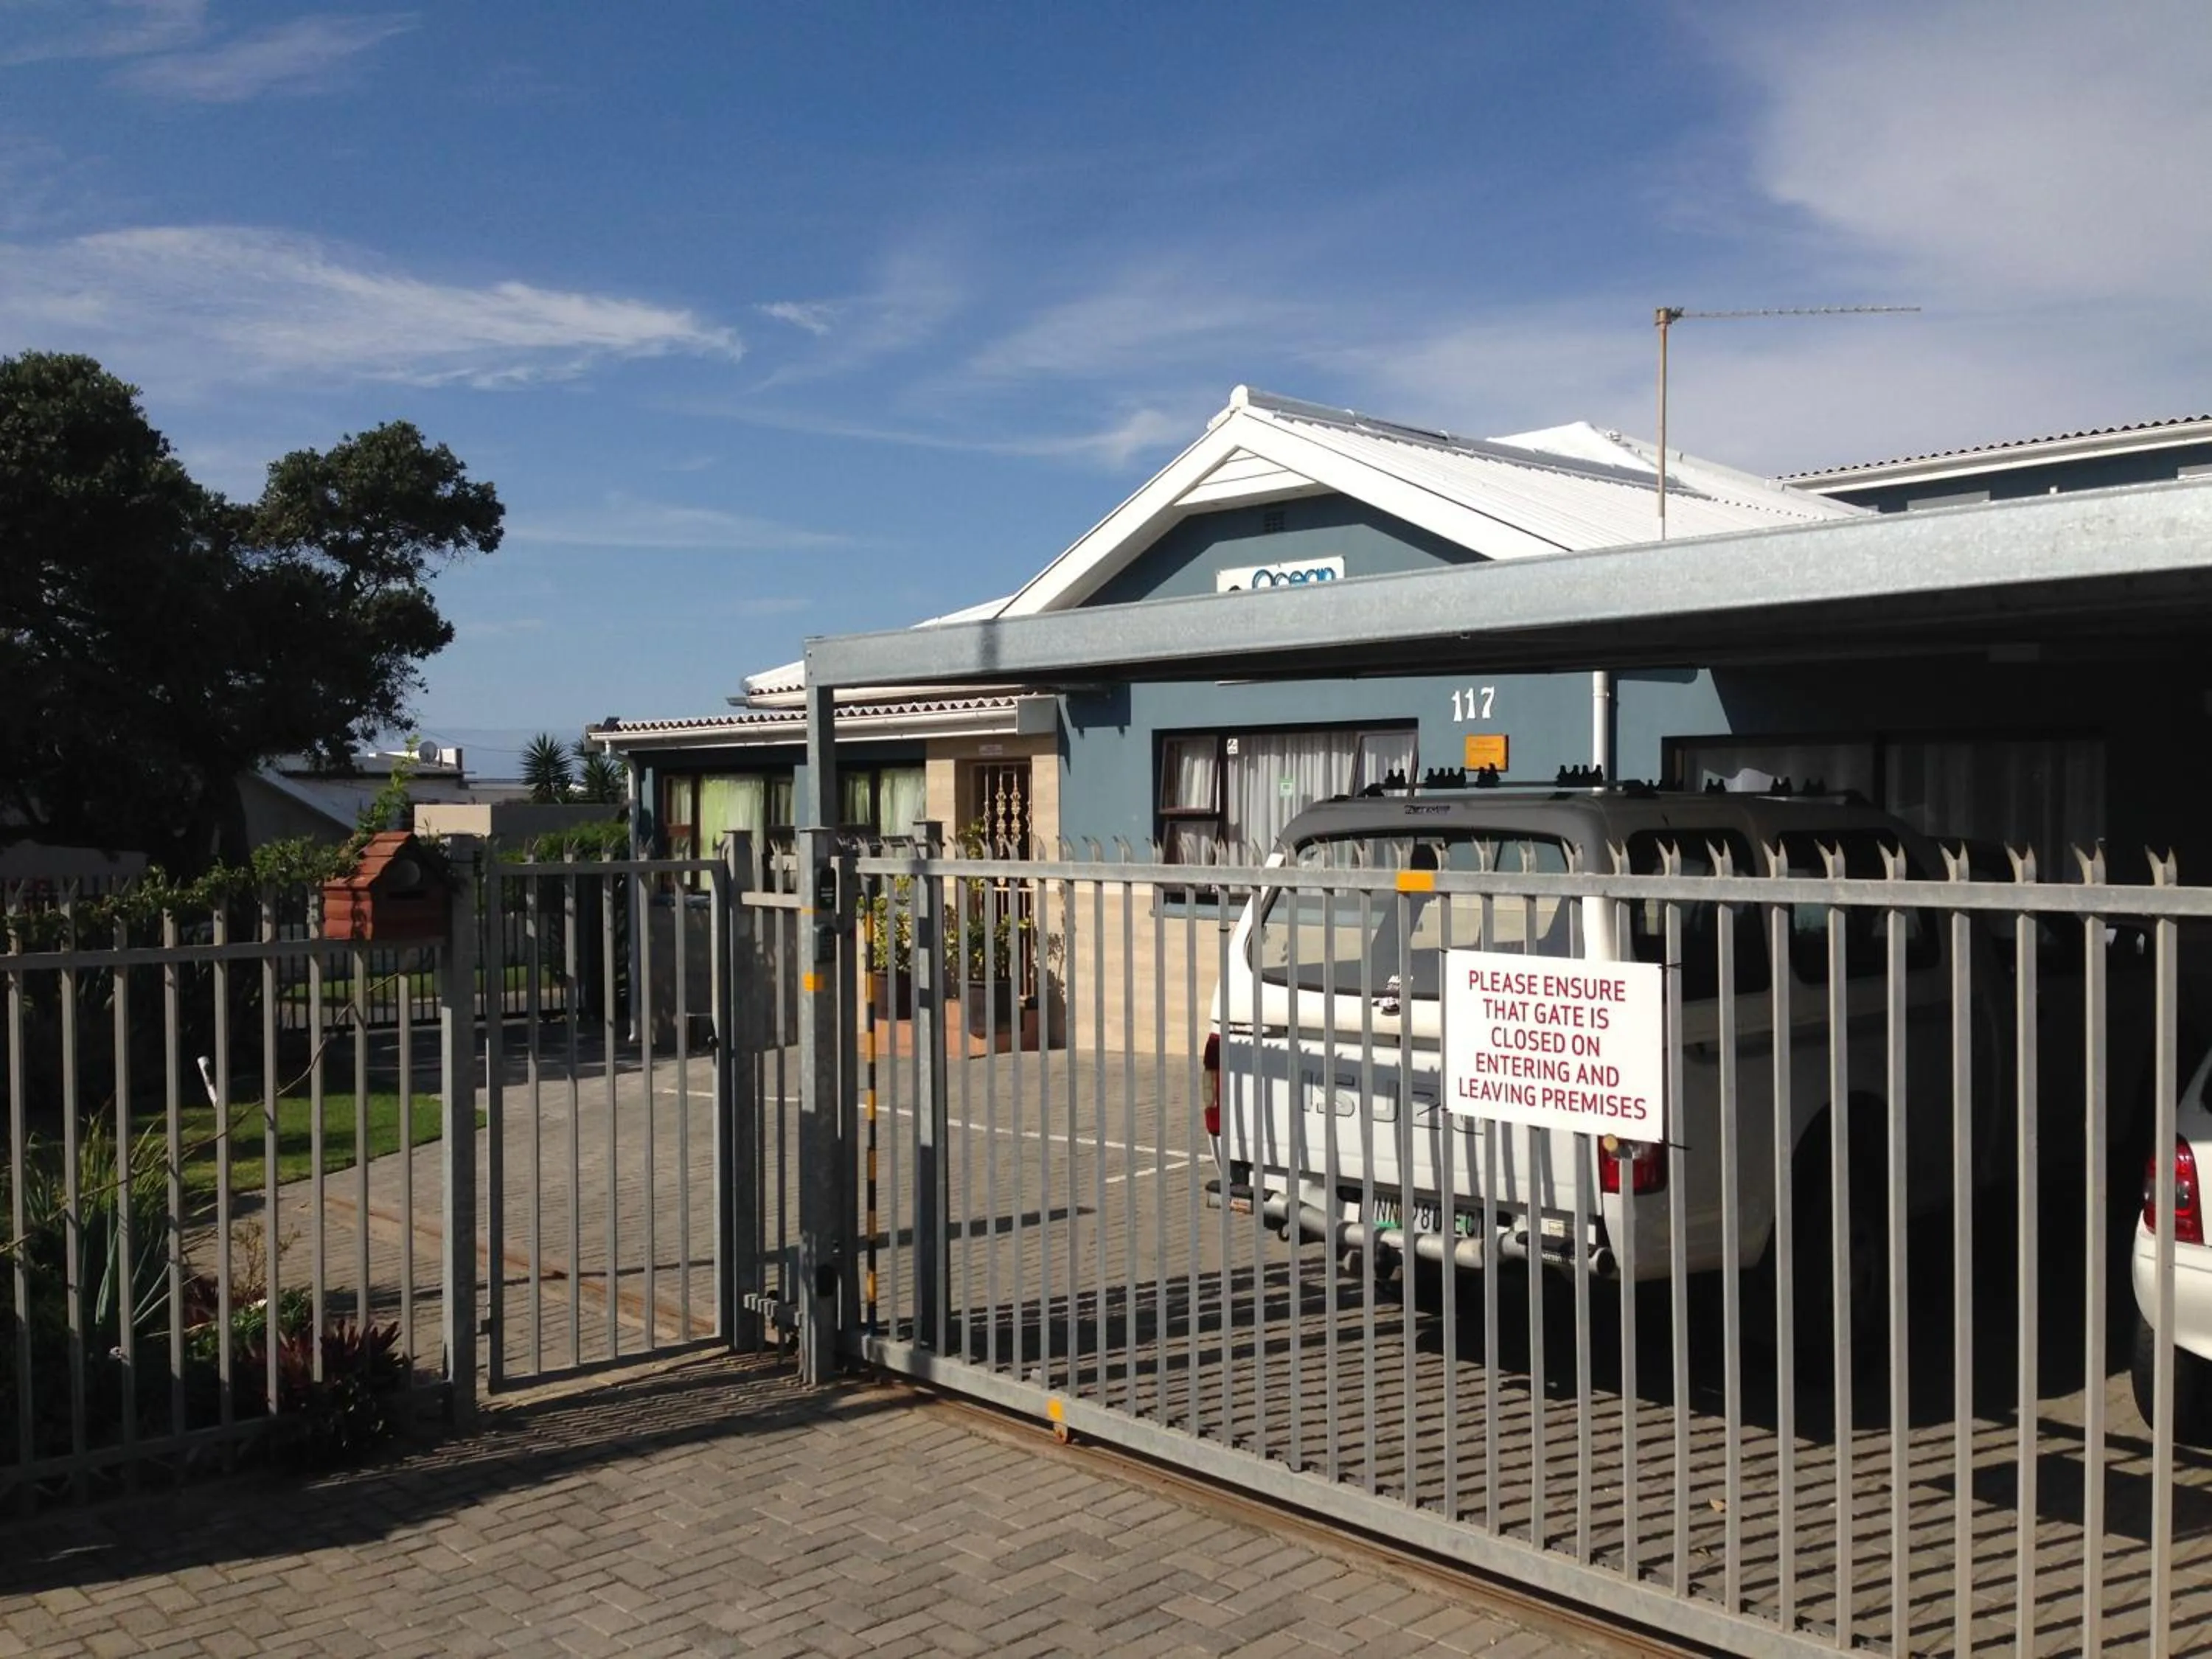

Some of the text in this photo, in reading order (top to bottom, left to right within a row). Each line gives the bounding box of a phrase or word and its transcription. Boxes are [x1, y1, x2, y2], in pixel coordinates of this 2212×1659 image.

[1252, 566, 1336, 590] Ocean
[1451, 686, 1495, 722] 117
[1469, 970, 1625, 1002] PLEASE ENSURE
[1484, 998, 1609, 1030] THAT GATE IS
[1492, 1027, 1601, 1057] CLOSED ON
[1476, 1052, 1620, 1088] ENTERING AND
[1301, 1069, 1485, 1135] ISUZ
[1459, 1077, 1646, 1120] LEAVING PREMISES
